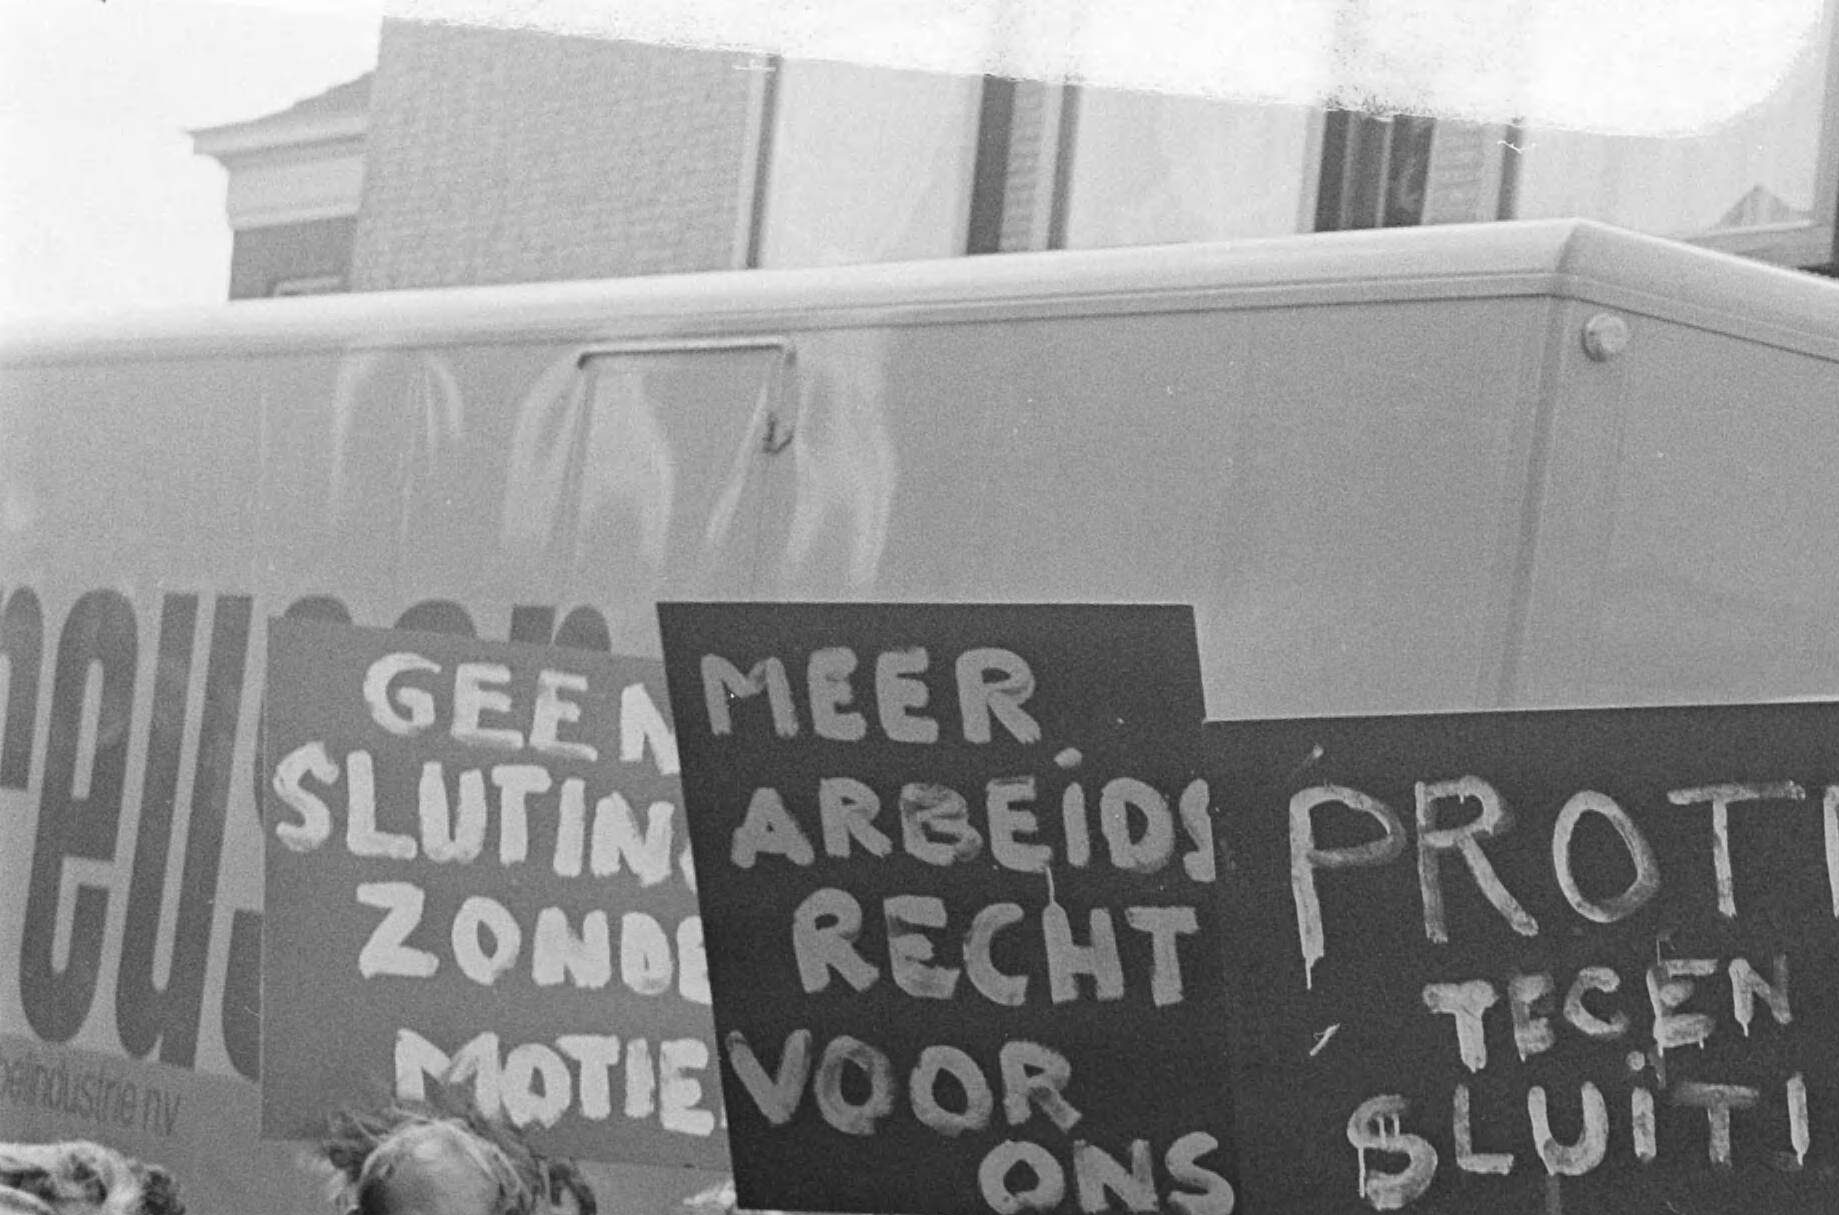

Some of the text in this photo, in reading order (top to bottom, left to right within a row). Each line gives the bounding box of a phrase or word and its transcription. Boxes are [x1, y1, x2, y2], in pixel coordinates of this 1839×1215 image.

[700, 647, 1041, 744] MEER
[272, 741, 698, 894] SLUTIN
[792, 887, 1199, 1007] RECHT
[726, 1028, 1081, 1136] VOOR
